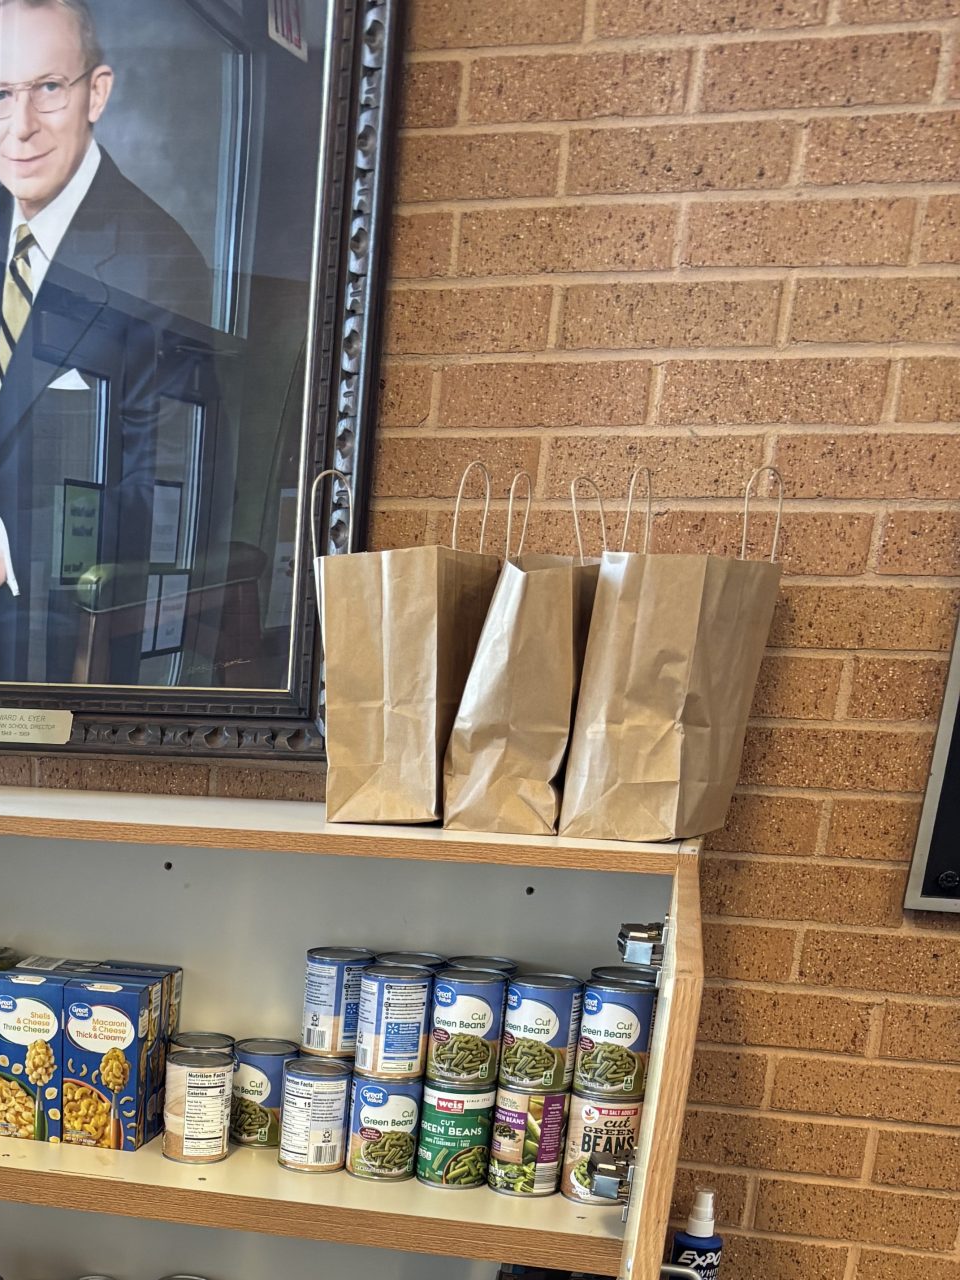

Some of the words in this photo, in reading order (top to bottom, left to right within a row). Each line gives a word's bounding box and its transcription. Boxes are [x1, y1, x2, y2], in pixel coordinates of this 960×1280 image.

[22, 1018, 50, 1026] Cheese
[471, 1013, 486, 1021] Cut
[92, 1018, 127, 1028] Macaroni
[435, 1017, 457, 1028] Green
[459, 1020, 486, 1029] Beans
[534, 1018, 551, 1027] Cut
[616, 1021, 633, 1031] Cut
[3, 1023, 22, 1031] Three
[22, 1025, 50, 1034] Cheese
[98, 1026, 127, 1035] Cheese
[505, 1021, 522, 1032] Green
[523, 1024, 550, 1035] Beans
[581, 1025, 602, 1036] Green
[603, 1029, 632, 1040] Beans
[249, 1080, 263, 1089] Cut
[240, 1087, 263, 1096] Beans
[438, 1100, 463, 1109] weis
[363, 1117, 388, 1126] Green
[391, 1118, 413, 1126] Beans
[506, 1115, 525, 1125] BEANS
[603, 1117, 631, 1128] cut
[421, 1120, 444, 1134] GREEN
[448, 1127, 482, 1136] BEANS
[584, 1126, 635, 1135] GREEN
[581, 1133, 634, 1154] BEANS
[678, 1250, 722, 1268] EXPO
